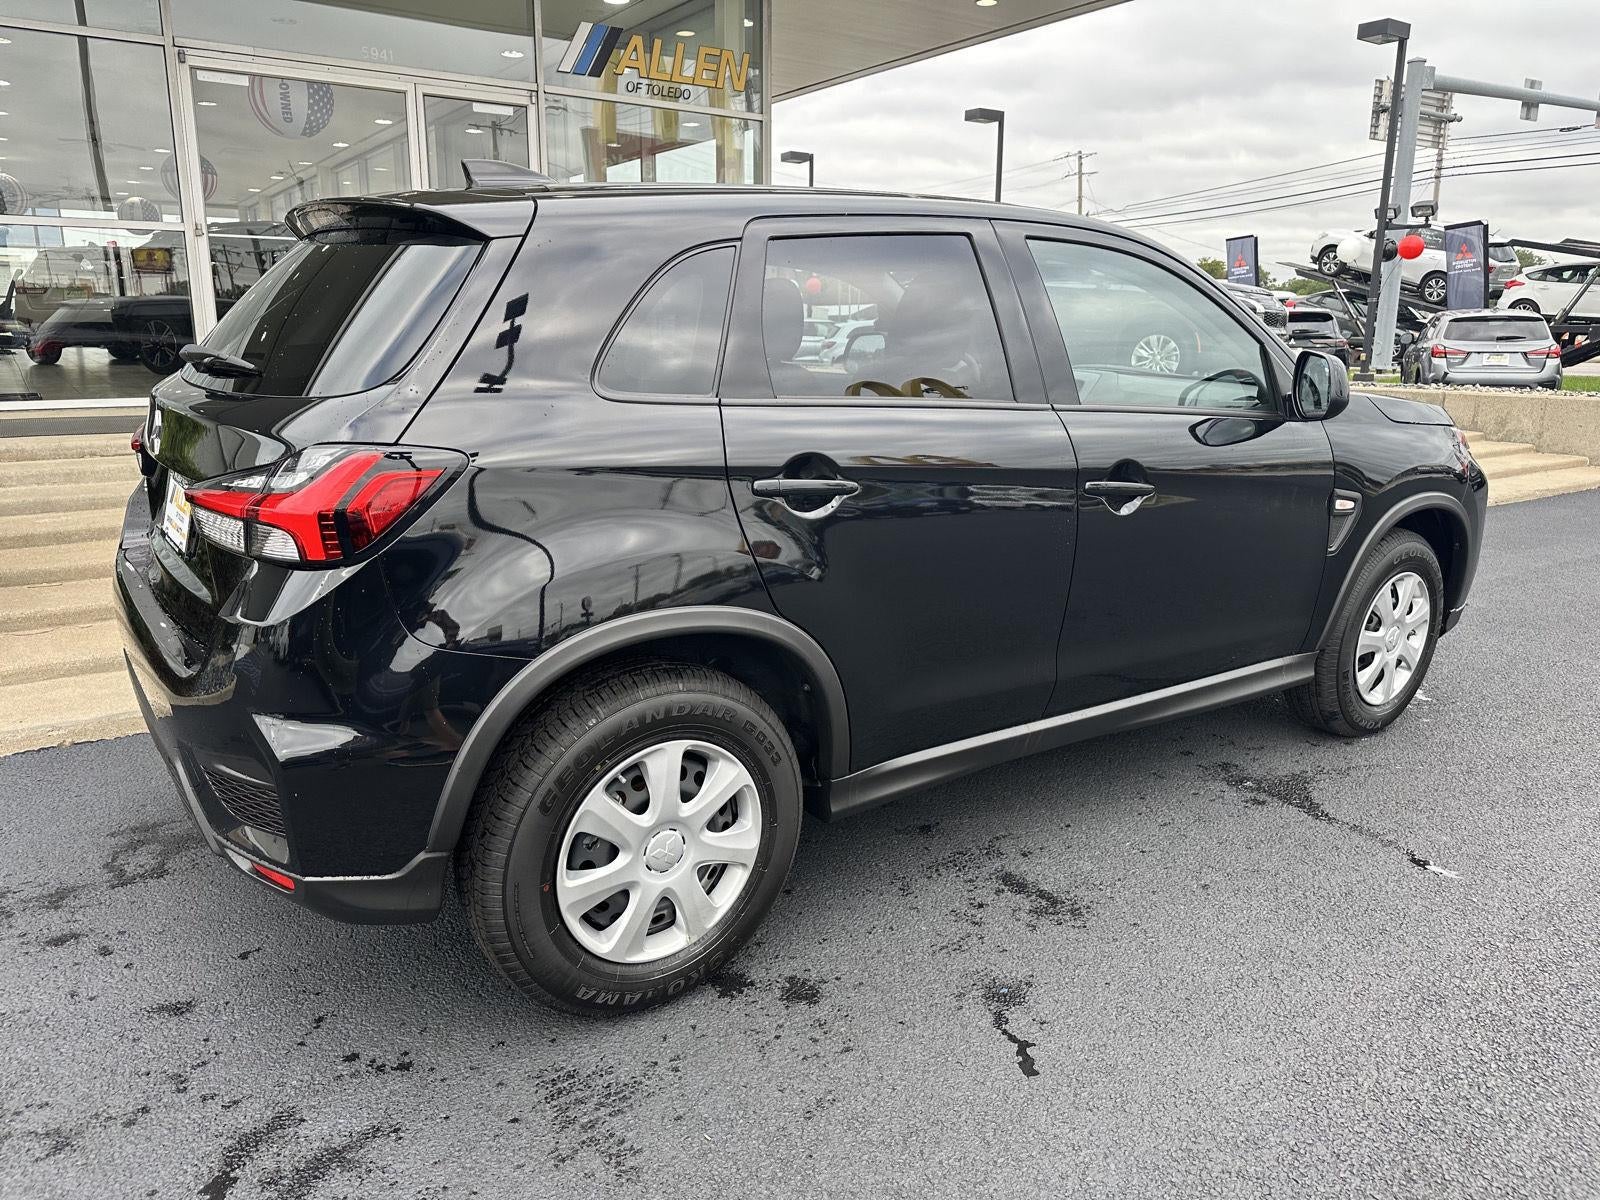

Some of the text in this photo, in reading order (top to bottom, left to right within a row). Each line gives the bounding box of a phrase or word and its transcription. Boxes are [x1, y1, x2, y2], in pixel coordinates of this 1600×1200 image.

[360, 46, 394, 64] 5941
[613, 34, 750, 92] ALLEN
[626, 80, 692, 100] OF TOLEDO
[538, 702, 739, 817] GEOLANDAR
